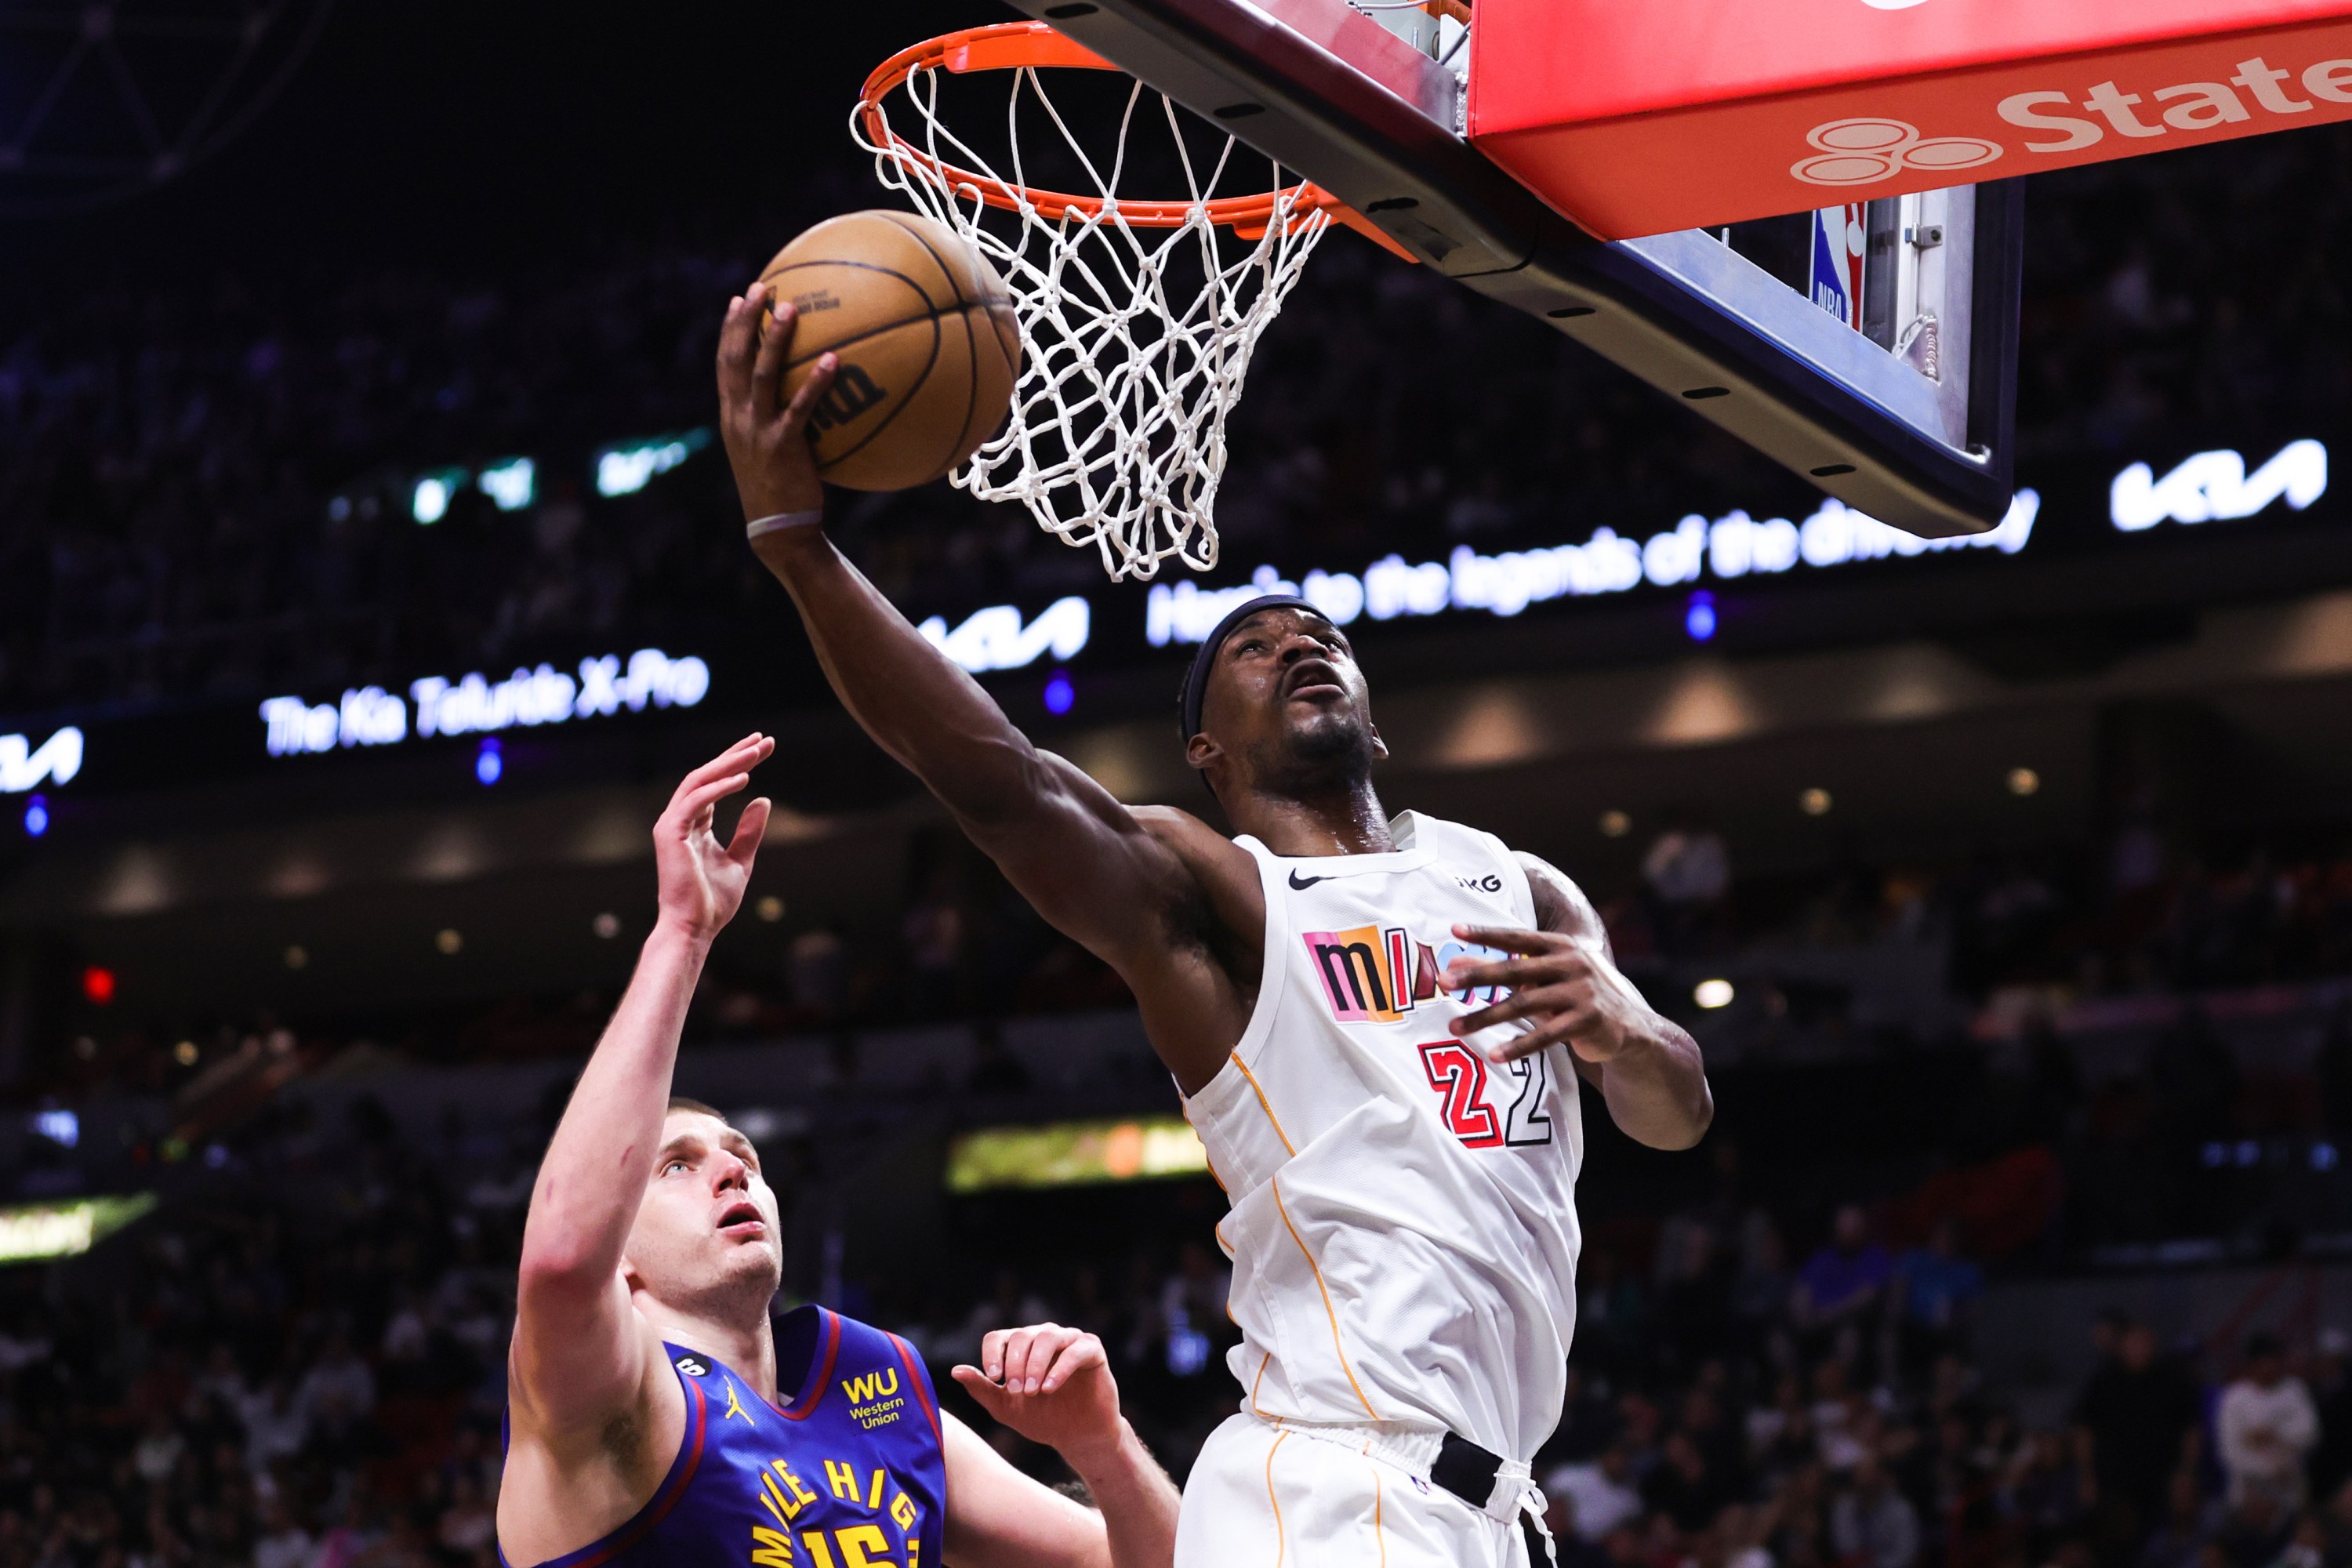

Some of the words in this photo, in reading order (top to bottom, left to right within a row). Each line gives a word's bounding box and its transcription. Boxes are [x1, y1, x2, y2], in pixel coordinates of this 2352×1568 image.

[1997, 57, 2352, 153] State
[1817, 281, 1842, 318] NBA
[1364, 554, 1450, 620] the
[1450, 527, 1643, 616] legends
[1643, 514, 1708, 585] of
[1710, 511, 1799, 578] the
[260, 696, 339, 756] The
[1417, 1039, 1551, 1149] 22
[841, 1368, 898, 1404] WU
[849, 1397, 904, 1420] Western
[862, 1412, 899, 1429] Union
[751, 1457, 818, 1568] MILE
